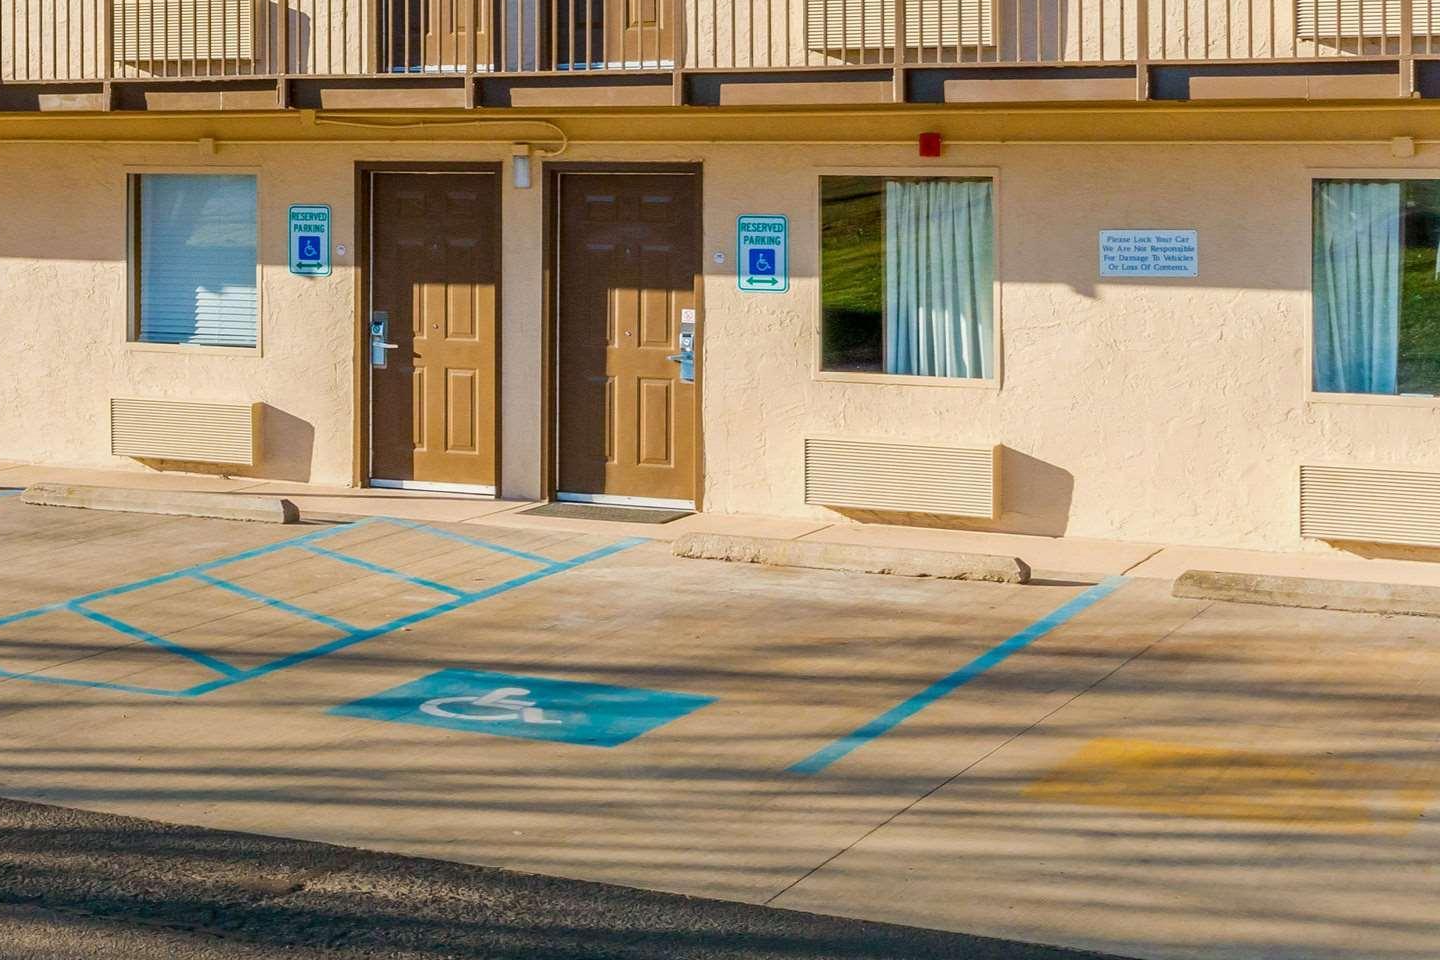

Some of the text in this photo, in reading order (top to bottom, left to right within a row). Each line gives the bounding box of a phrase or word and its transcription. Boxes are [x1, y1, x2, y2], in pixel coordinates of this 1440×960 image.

[291, 212, 327, 221] RESERVED
[293, 224, 325, 233] PARKING
[740, 222, 784, 233] RESERVED
[743, 235, 782, 246] PARKING
[1107, 235, 1190, 243] Please Lock Your Car
[1151, 245, 1195, 253] Responsible
[1108, 263, 1119, 271] Or
[1121, 263, 1138, 271] Loss
[1140, 263, 1151, 271] Of
